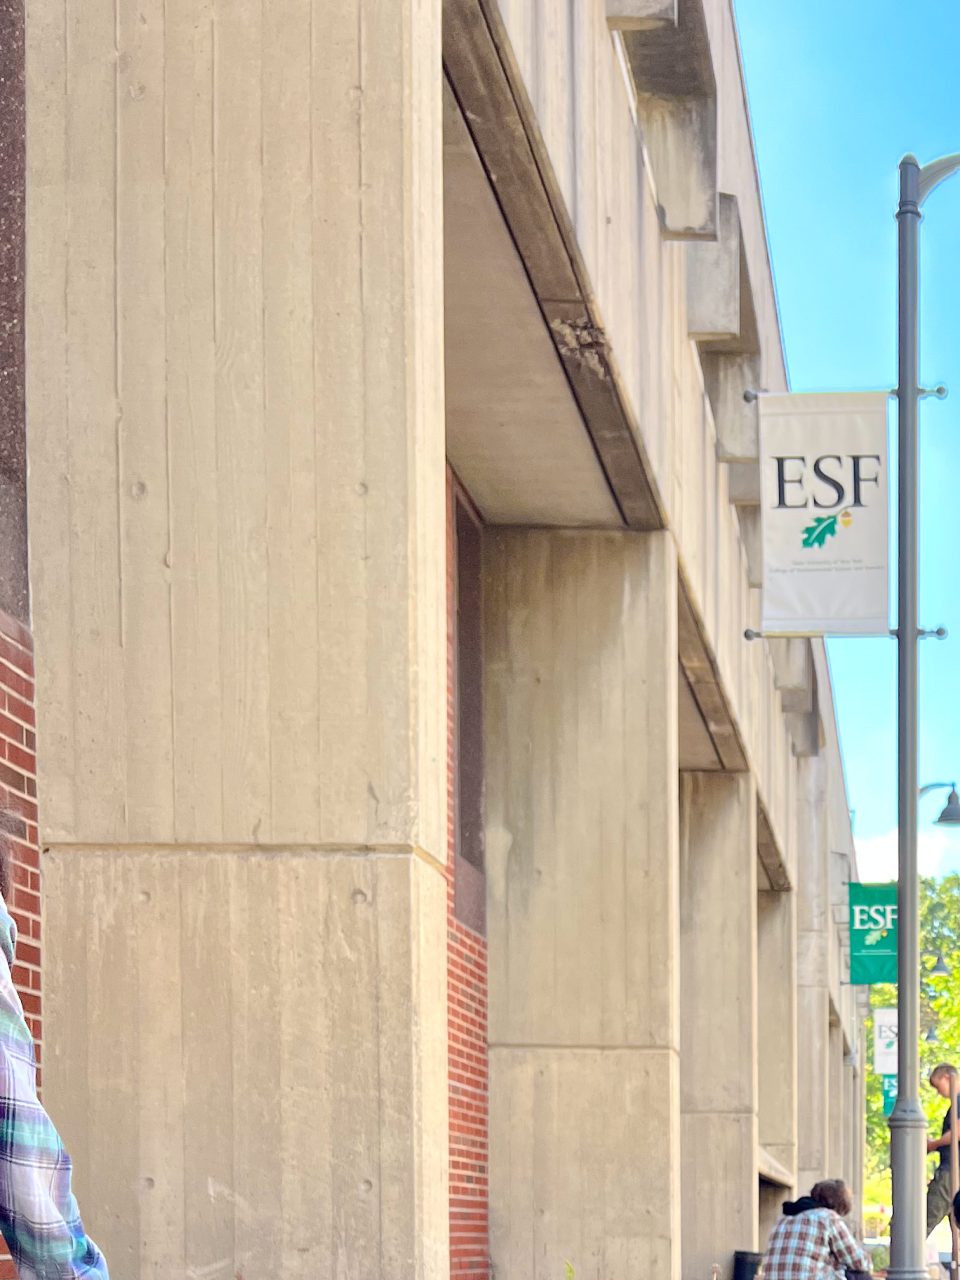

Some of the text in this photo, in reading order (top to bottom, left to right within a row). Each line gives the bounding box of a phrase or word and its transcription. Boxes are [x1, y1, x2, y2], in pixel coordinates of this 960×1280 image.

[770, 454, 882, 509] ESF
[852, 905, 898, 930] ESF
[878, 1024, 898, 1040] ES
[883, 1078, 898, 1091] ES
